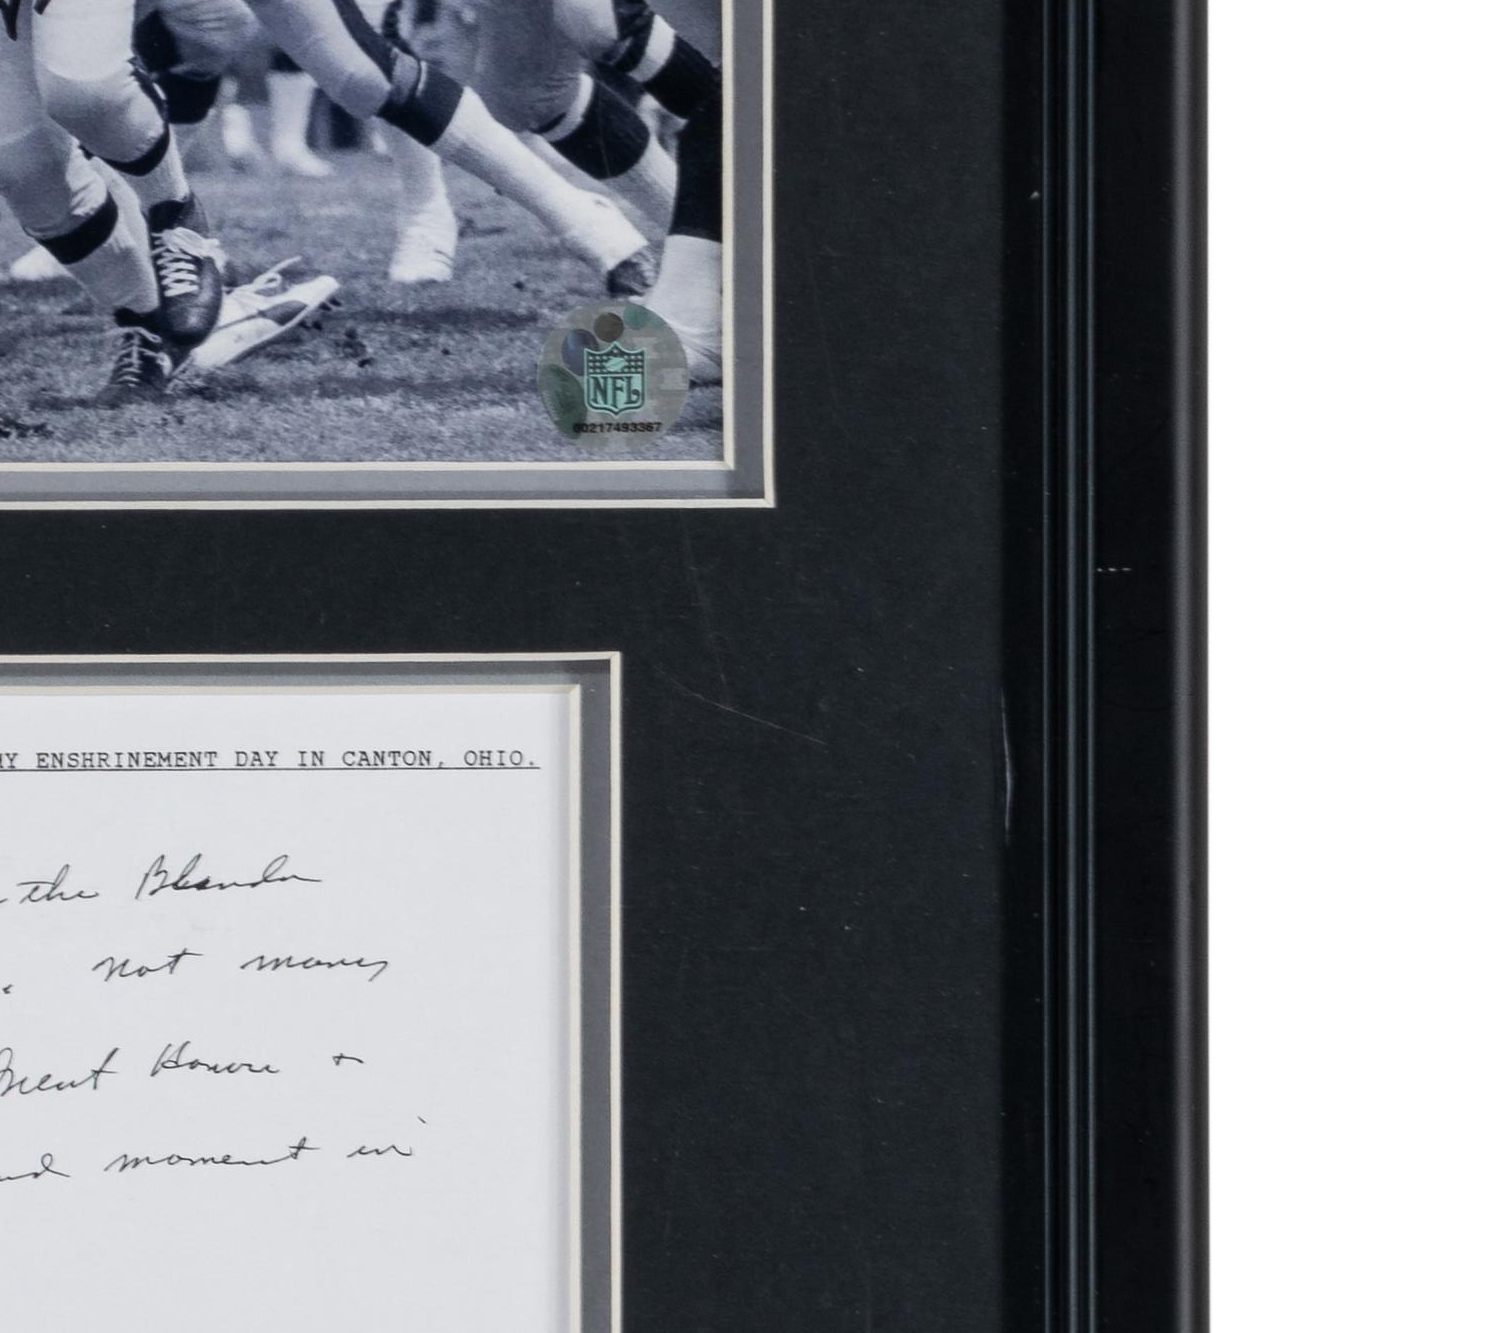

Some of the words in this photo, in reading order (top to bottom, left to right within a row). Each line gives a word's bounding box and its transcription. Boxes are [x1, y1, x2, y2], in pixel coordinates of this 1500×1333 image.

[590, 376, 641, 408] NFL
[34, 752, 218, 770] ENSHRINEMENT
[234, 751, 279, 769] DAY
[296, 750, 325, 769] IN
[340, 750, 447, 769] CANTON,
[461, 749, 535, 768] OHIO.
[17, 863, 100, 904] the
[134, 852, 322, 900] Blanda
[103, 1136, 319, 1173] moment
[346, 1116, 427, 1159] in
